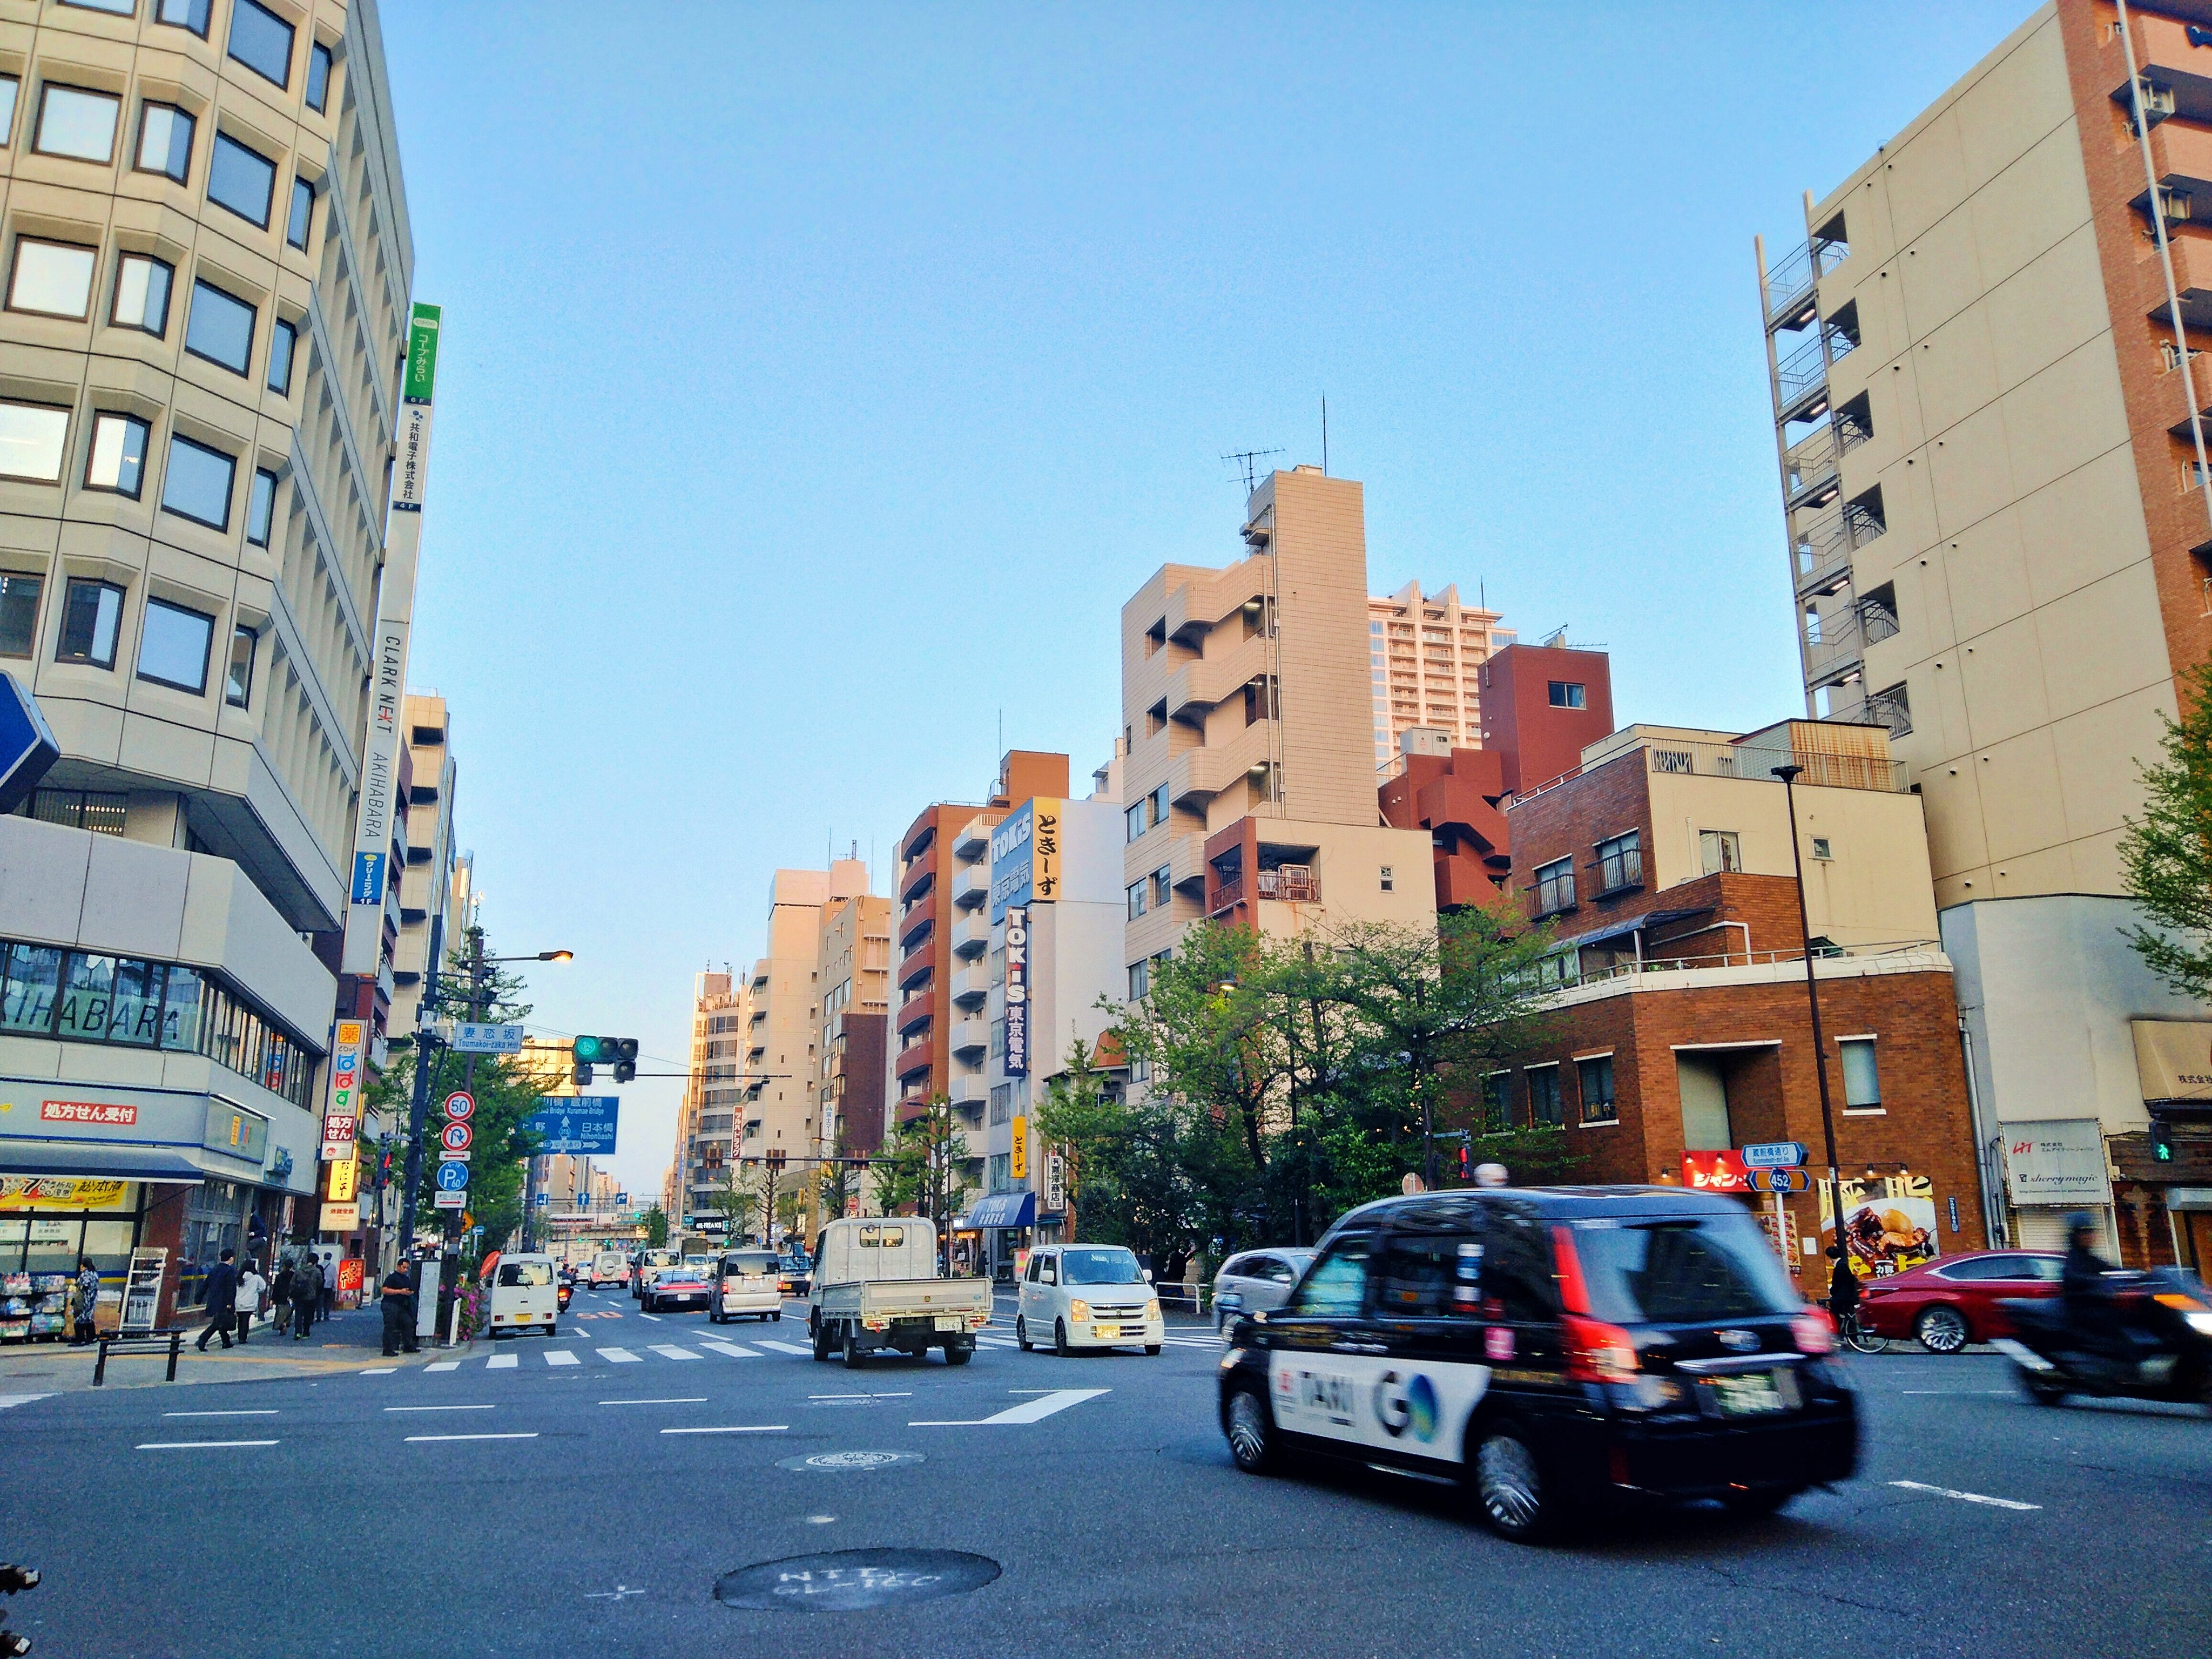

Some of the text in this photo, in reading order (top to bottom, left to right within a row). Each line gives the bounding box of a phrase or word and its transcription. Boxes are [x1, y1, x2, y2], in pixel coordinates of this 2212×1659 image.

[415, 334, 429, 382] コープみらい
[403, 422, 420, 500] 共和電子株式会社
[377, 636, 401, 734] CLARK NEXT
[365, 752, 388, 837] AKIHABARA
[1036, 814, 1058, 896] ときーず
[992, 859, 1030, 908] 東京電気
[0, 989, 178, 1040] IHABARA
[341, 1026, 359, 1042] 薬
[463, 1027, 515, 1040] 妻恋坂
[1008, 1006, 1024, 1069] 東京電気
[458, 1039, 505, 1048] Tsumakoi-zaka
[44, 1103, 135, 1123] 処方せん受付
[451, 1100, 468, 1113] 50
[327, 1116, 353, 1129] 処方
[582, 1122, 613, 1132] 日本橋
[327, 1129, 351, 1141] せん
[732, 1111, 742, 1157] ツルハドラッグ
[1014, 1136, 1023, 1172] ときーず
[443, 1169, 461, 1188] P 60
[1693, 1172, 1749, 1188] ジャン・
[1771, 1175, 1790, 1187] 452
[2030, 1174, 2098, 1185] sherry magic
